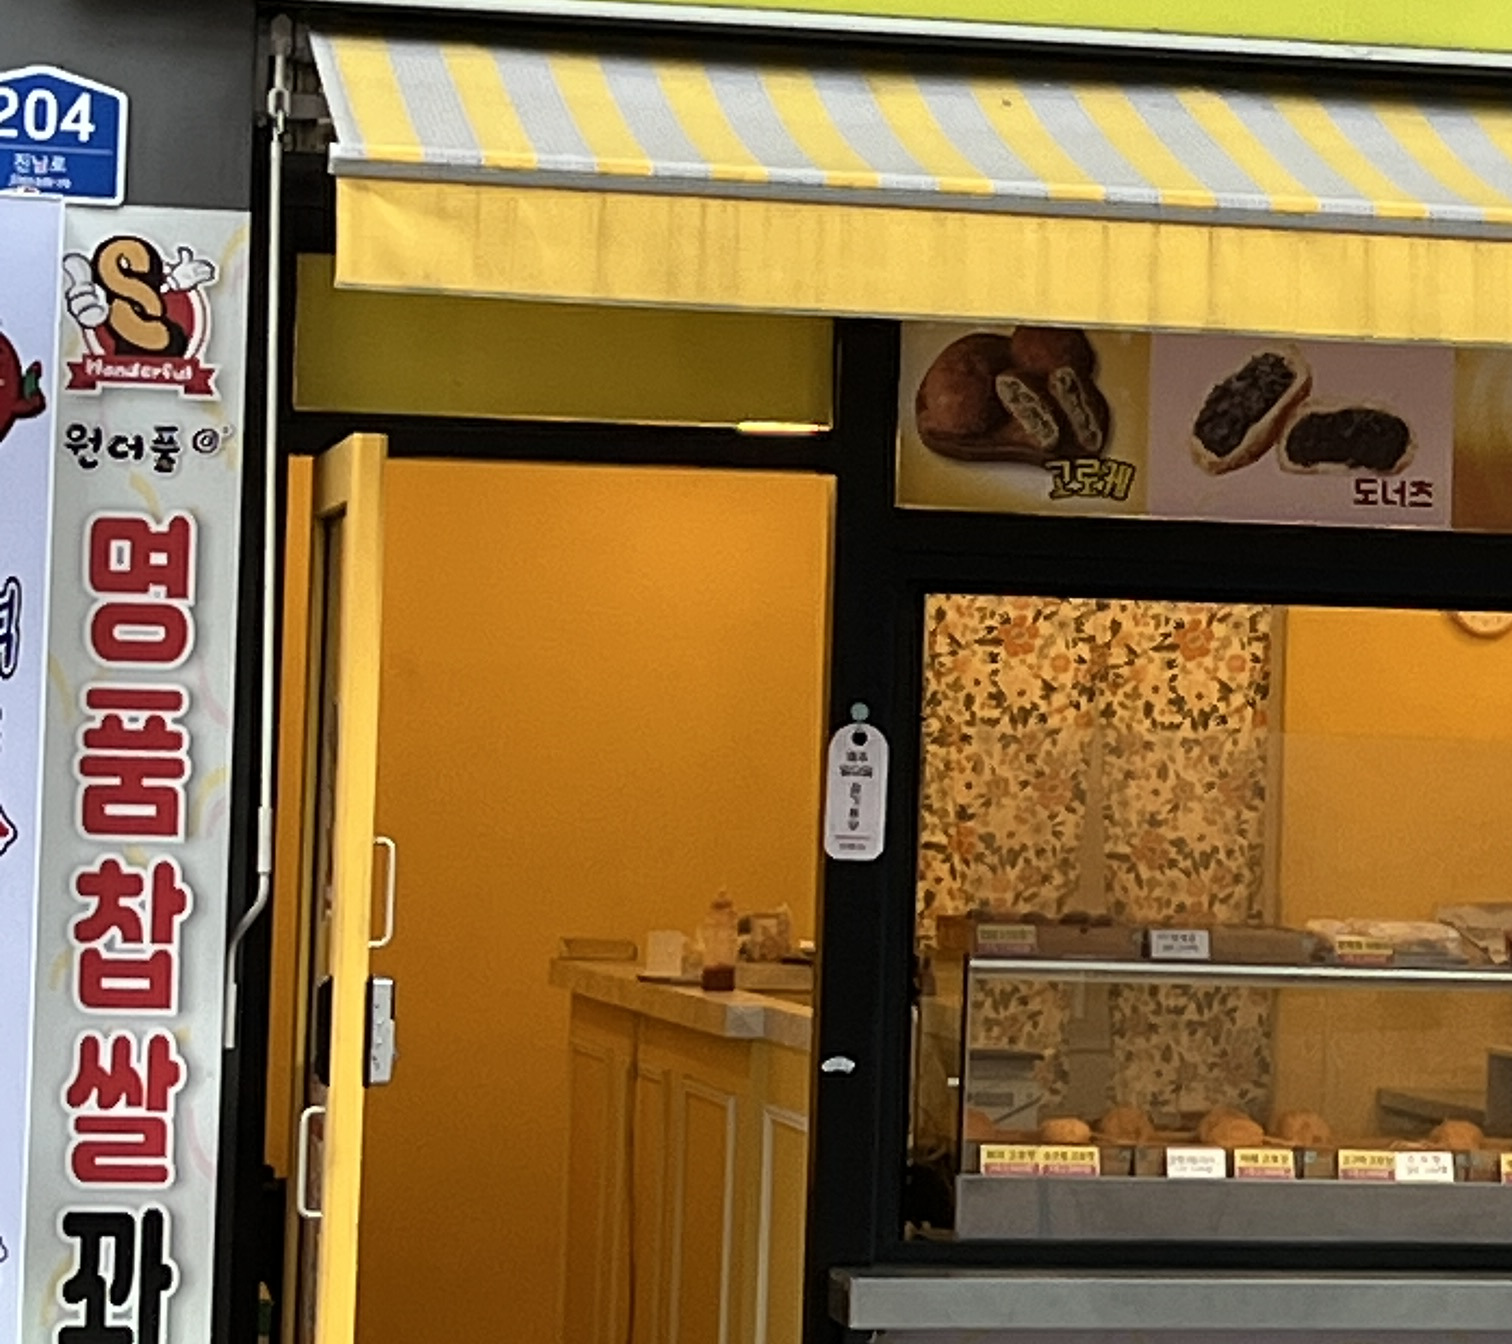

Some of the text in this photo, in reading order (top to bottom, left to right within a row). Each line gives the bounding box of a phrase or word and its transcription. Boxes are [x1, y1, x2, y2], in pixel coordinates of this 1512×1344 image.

[0, 86, 96, 143] 204
[85, 358, 193, 381] Wonderful
[64, 422, 181, 473] 원더풀
[1044, 457, 1136, 502] 고로케
[1353, 478, 1433, 507] 도너츠
